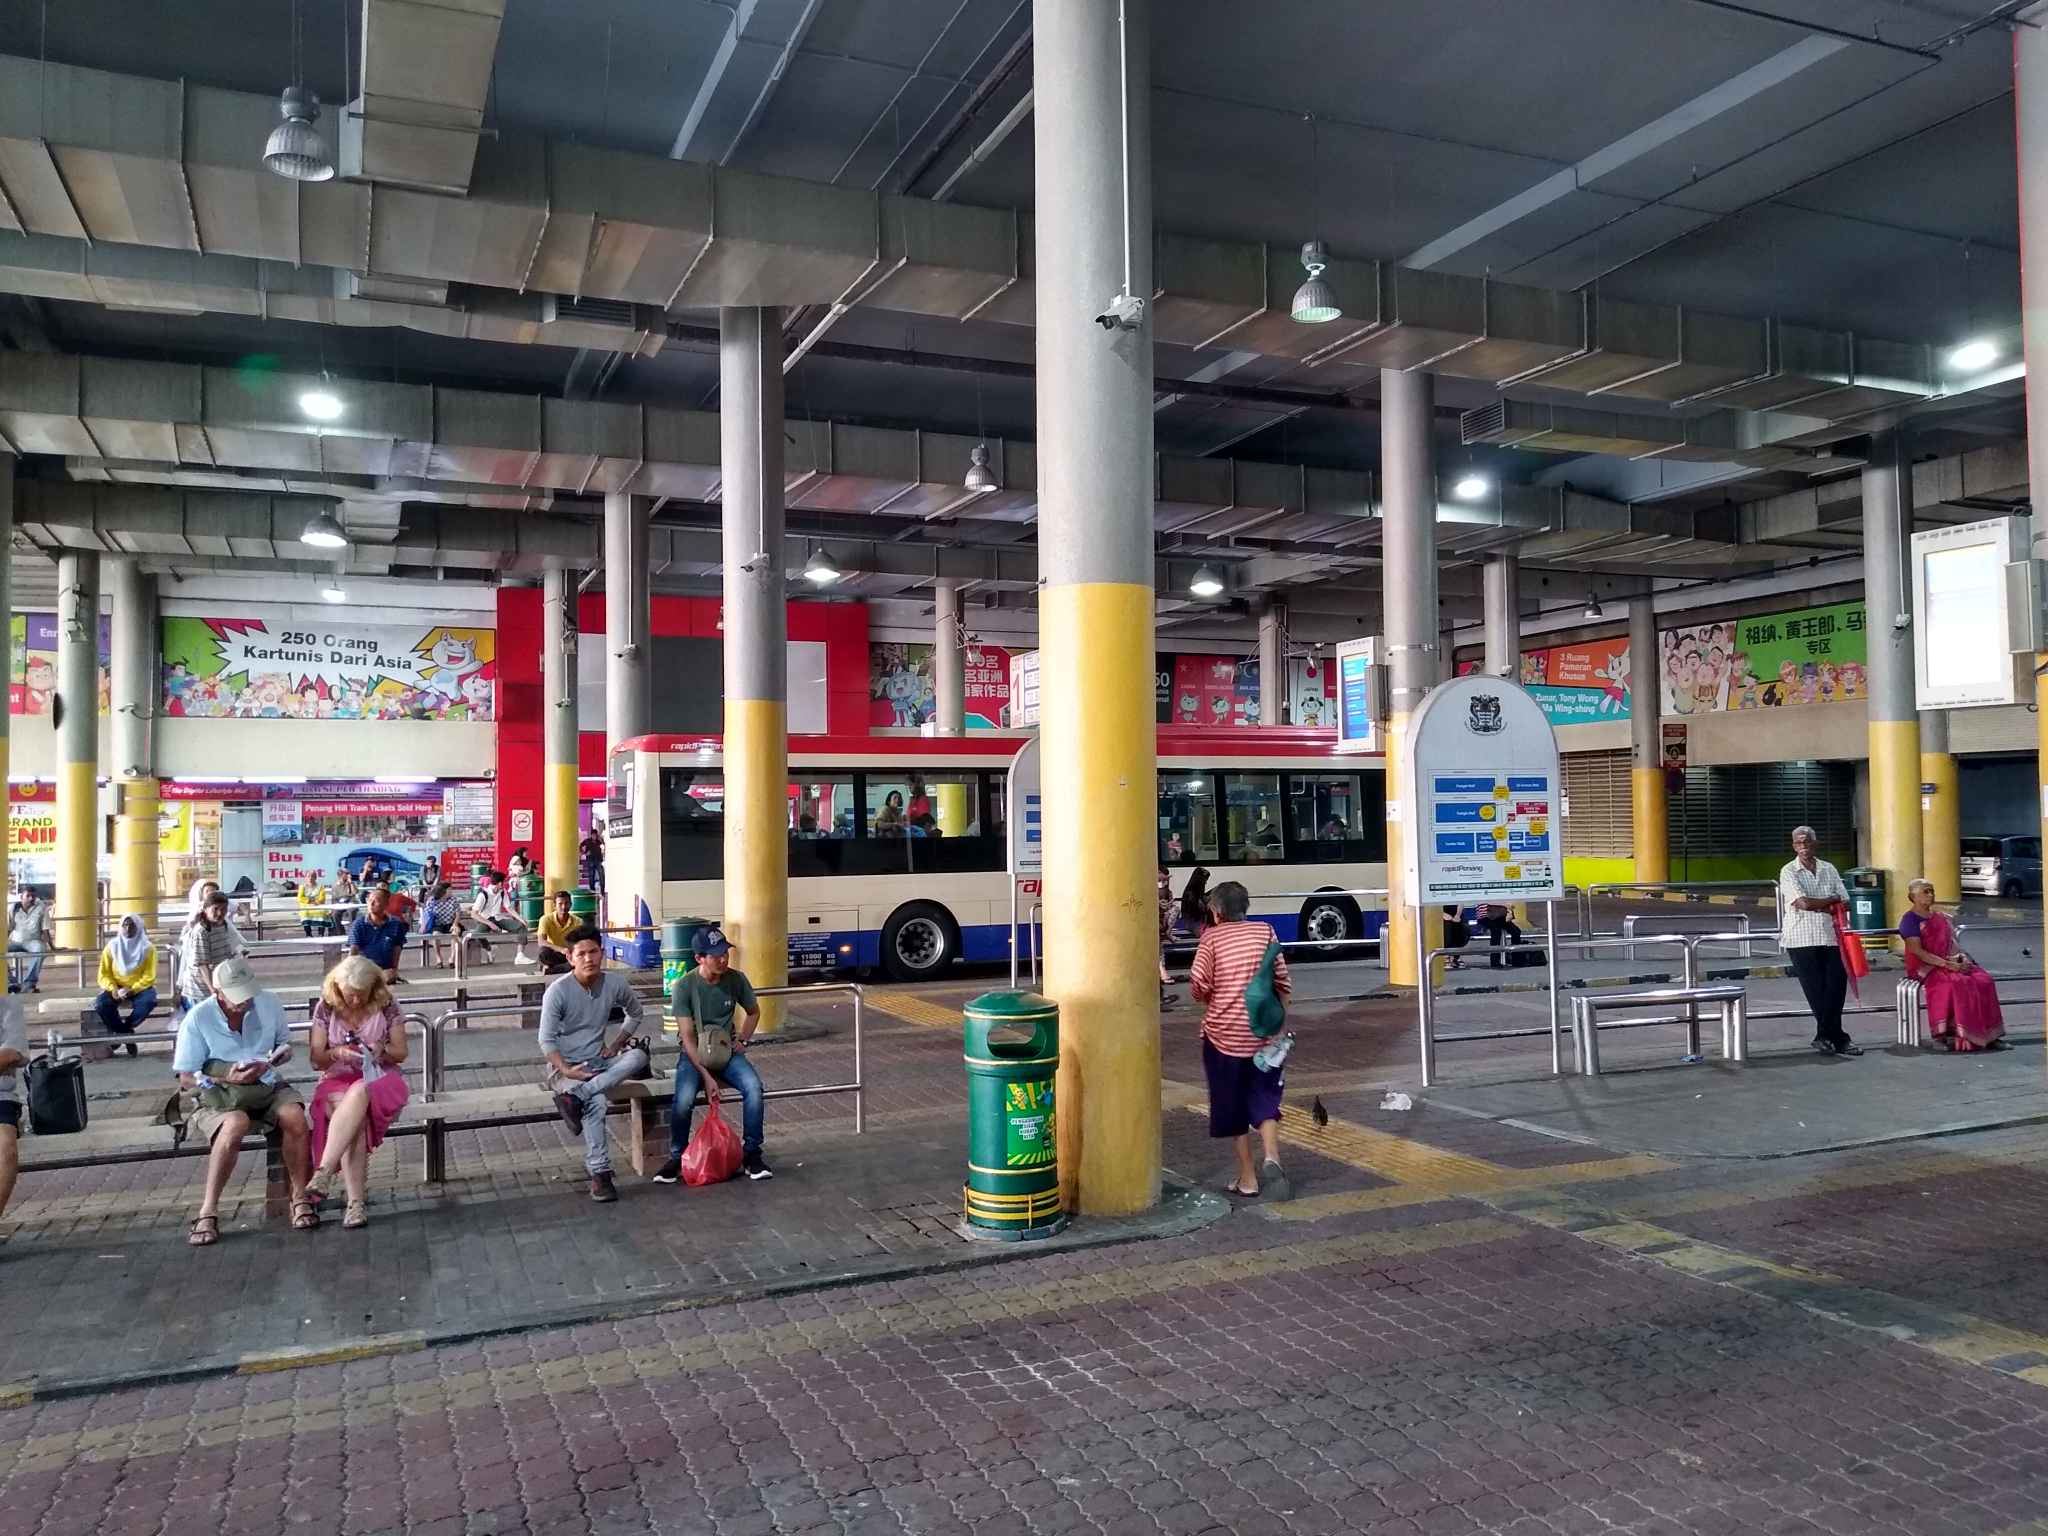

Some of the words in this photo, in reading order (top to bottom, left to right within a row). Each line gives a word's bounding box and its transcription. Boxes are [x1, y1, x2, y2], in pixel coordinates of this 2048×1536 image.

[1745, 610, 1867, 646] 祖纳、黄玉郎、马
[281, 632, 316, 646] 250
[324, 634, 378, 653] Orang
[1806, 638, 1832, 655] 专区
[243, 645, 323, 663] Kartunis
[330, 651, 367, 666] Dari
[374, 655, 412, 670] Asia
[1566, 653, 1590, 663] Ruang
[1560, 663, 1592, 671] Pameran
[1559, 672, 1586, 680] Khusus
[1560, 694, 1577, 704] Tony
[1554, 704, 1596, 715] Wing-shing
[304, 804, 333, 813] Penang
[335, 804, 348, 812] Hill
[350, 804, 369, 812] Train
[370, 804, 396, 812] Tickets
[397, 804, 413, 812] Sold
[446, 801, 453, 812] 5
[268, 851, 303, 863] Bus
[268, 867, 326, 879] Tickt
